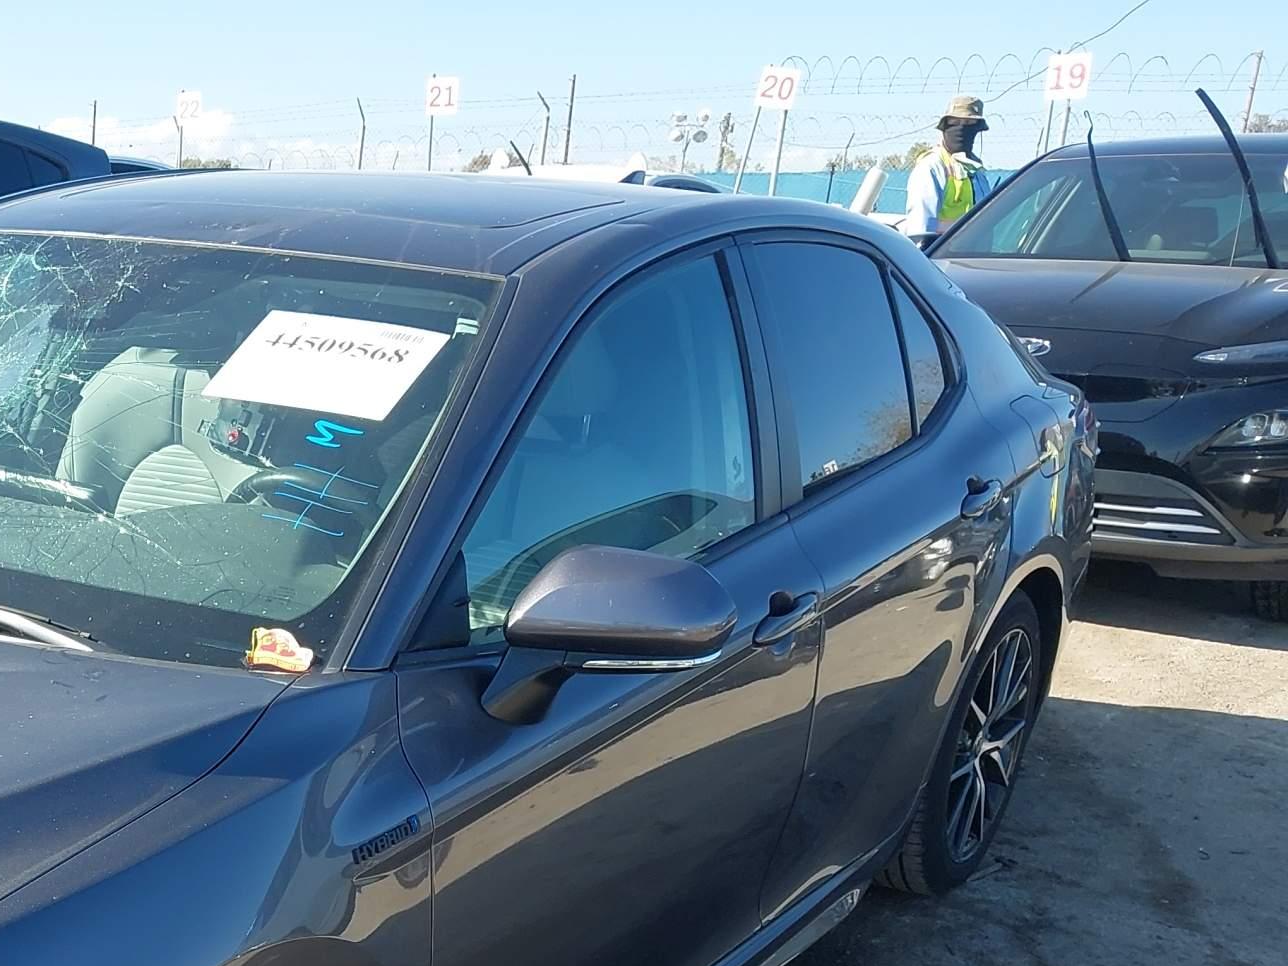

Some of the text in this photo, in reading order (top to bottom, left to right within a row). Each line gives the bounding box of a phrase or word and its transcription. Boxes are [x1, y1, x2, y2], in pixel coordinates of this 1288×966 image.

[760, 75, 794, 100] 20
[1049, 63, 1087, 90] 19
[179, 99, 200, 119] 22
[429, 86, 455, 107] 21
[265, 332, 410, 364] 44509568
[351, 821, 412, 865] HYBRID
